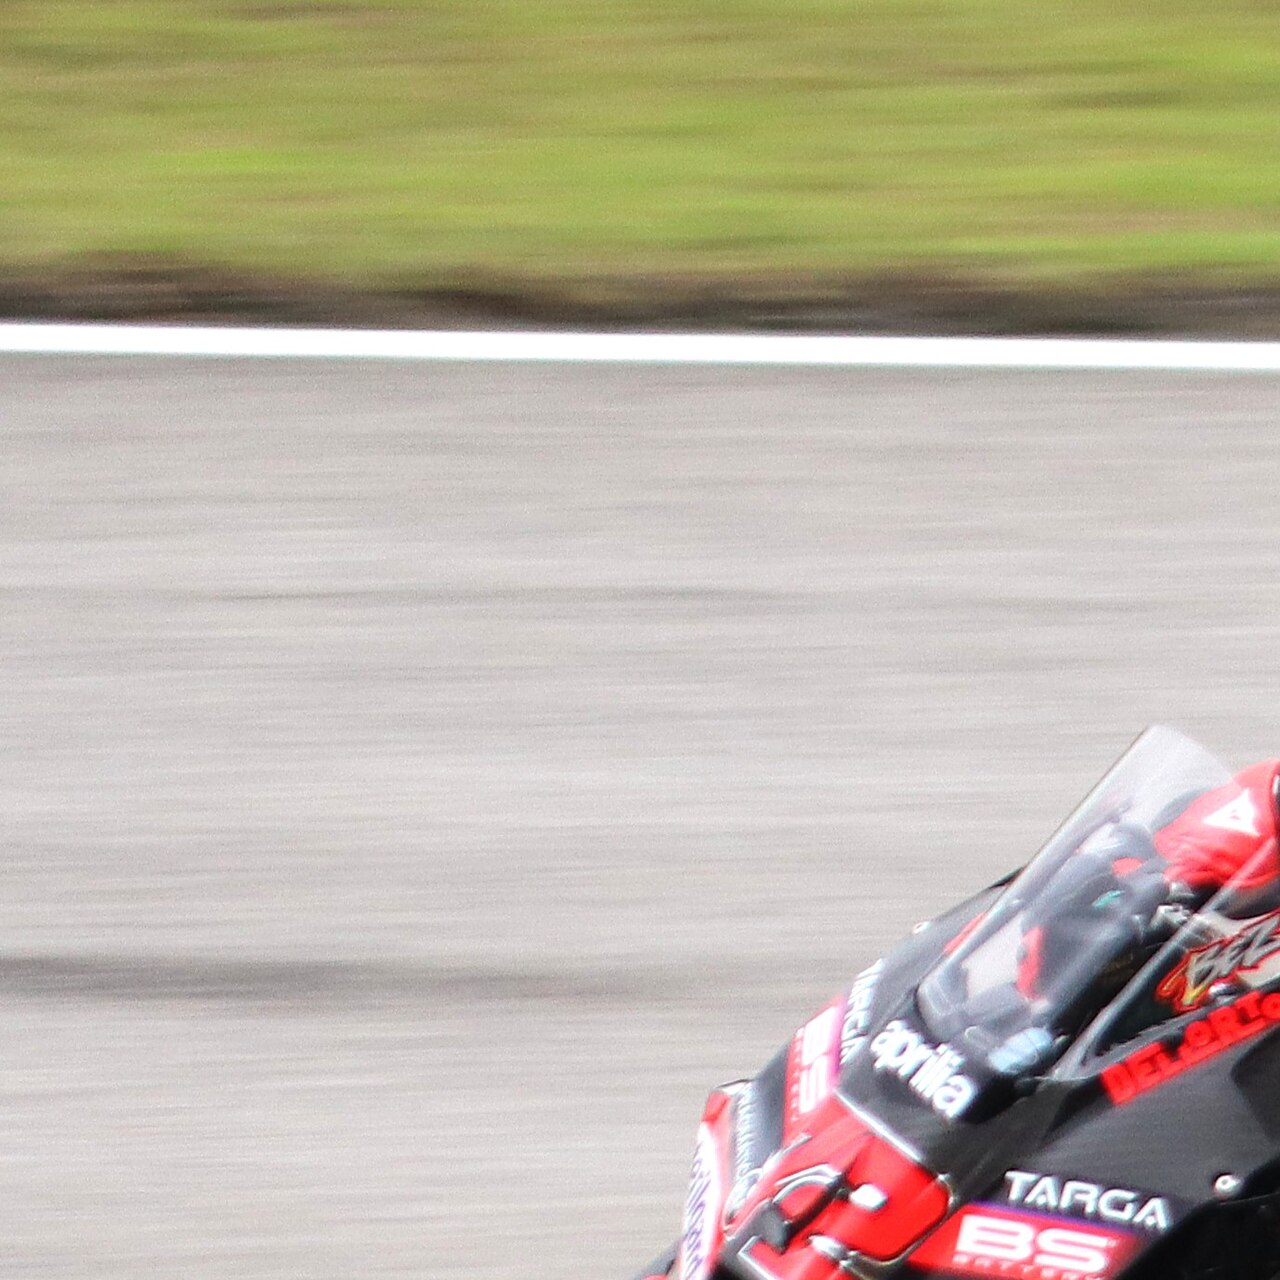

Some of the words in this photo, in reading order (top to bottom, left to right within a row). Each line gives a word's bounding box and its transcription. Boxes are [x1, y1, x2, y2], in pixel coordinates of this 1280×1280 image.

[870, 1018, 977, 1119] aprilia
[1004, 1168, 1175, 1231] TARGA
[955, 1213, 1112, 1274] BS
